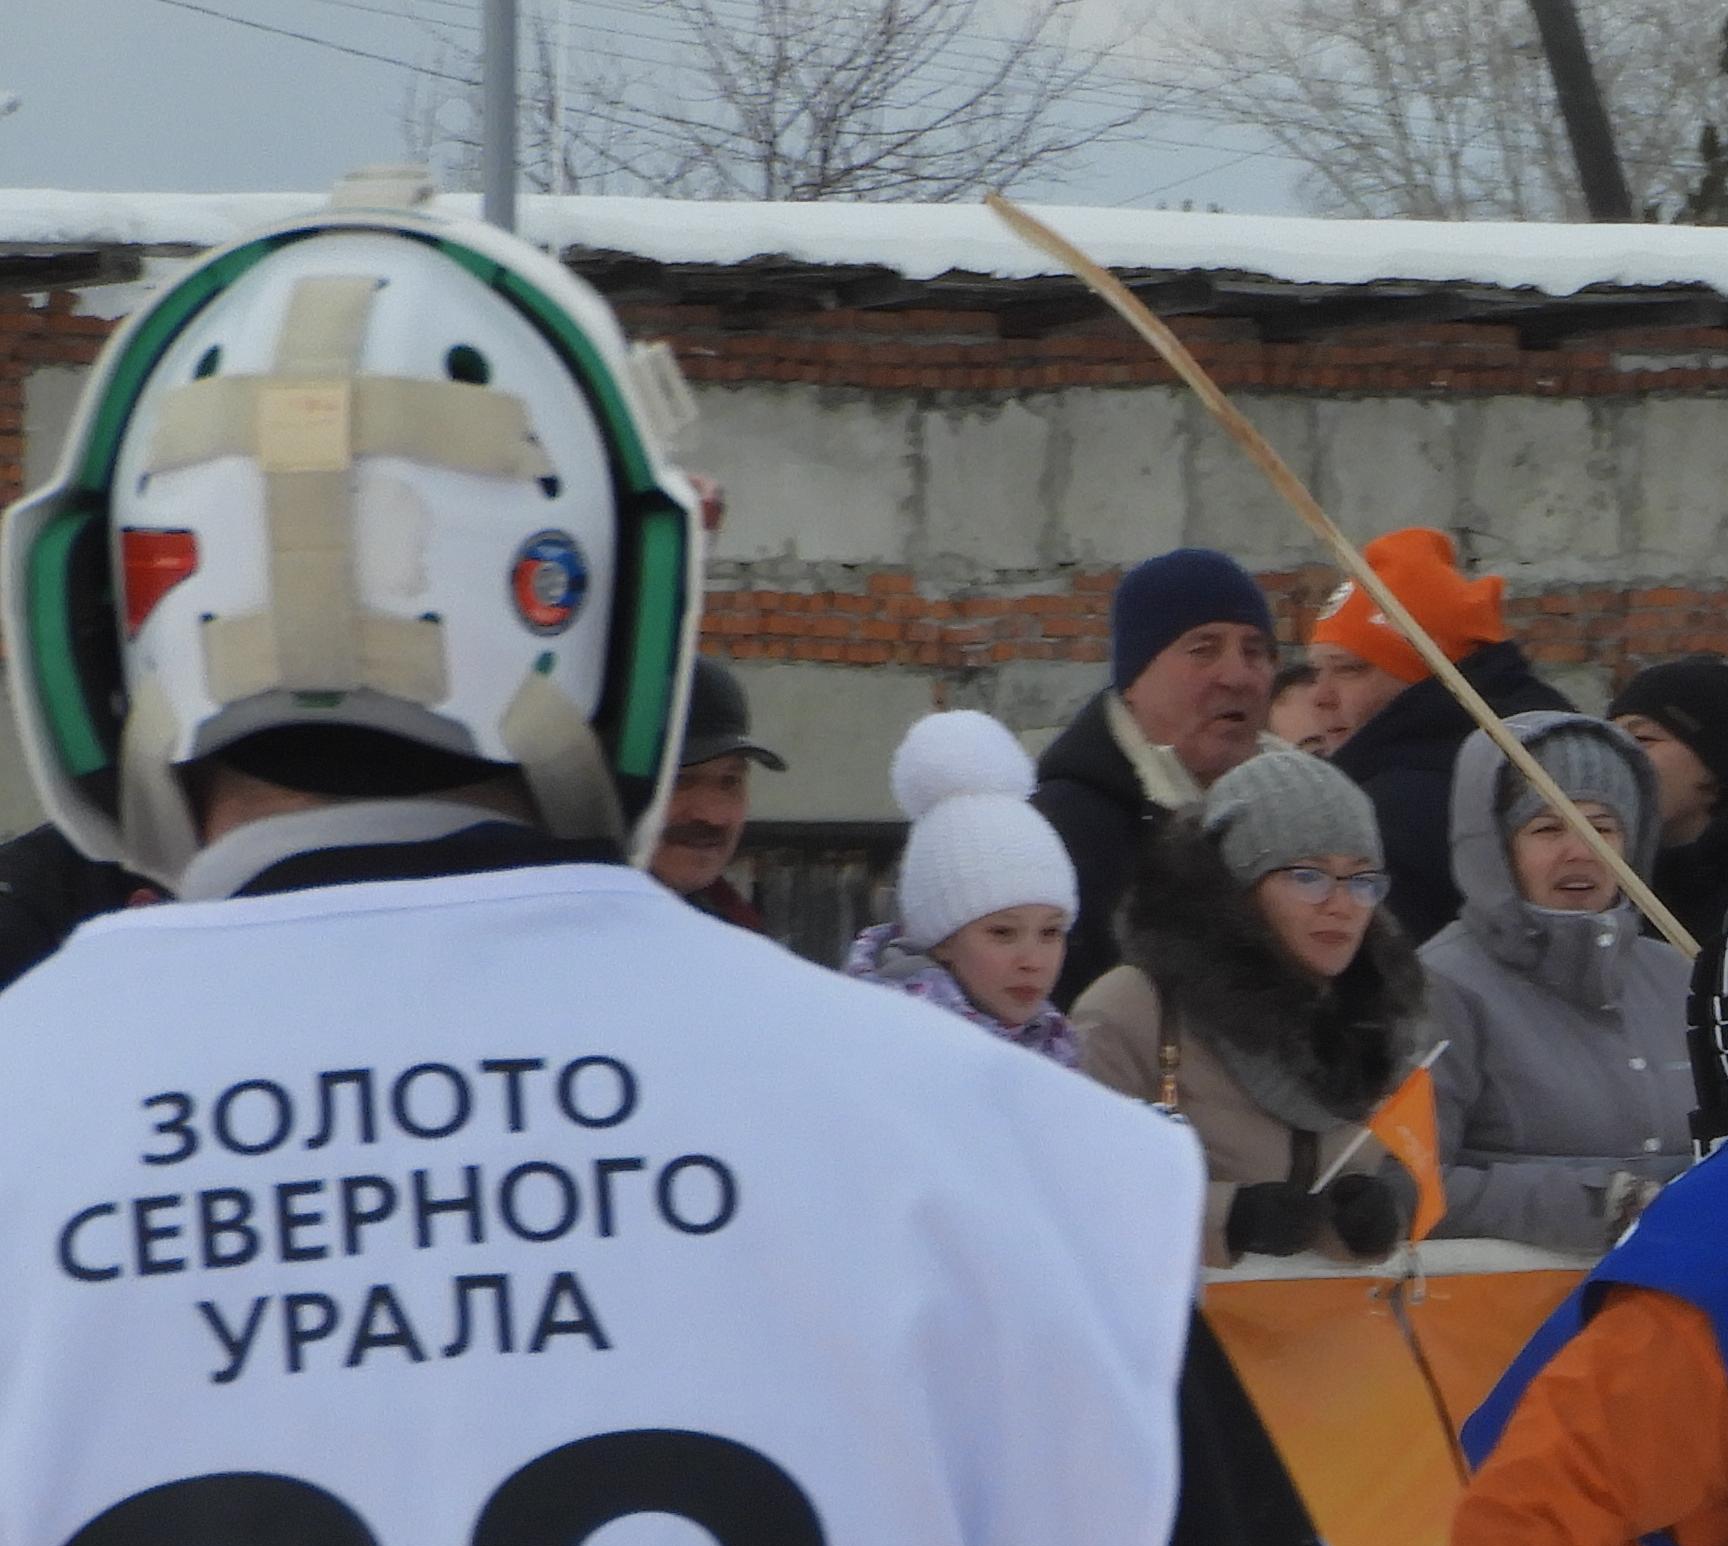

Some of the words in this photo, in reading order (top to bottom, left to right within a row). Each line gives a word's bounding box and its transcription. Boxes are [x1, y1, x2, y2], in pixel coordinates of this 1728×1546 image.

[141, 1054, 641, 1167] ЗОЛОТО
[56, 1152, 739, 1283] СЕВЕРНОГО
[198, 1271, 614, 1385] УРАЛА
